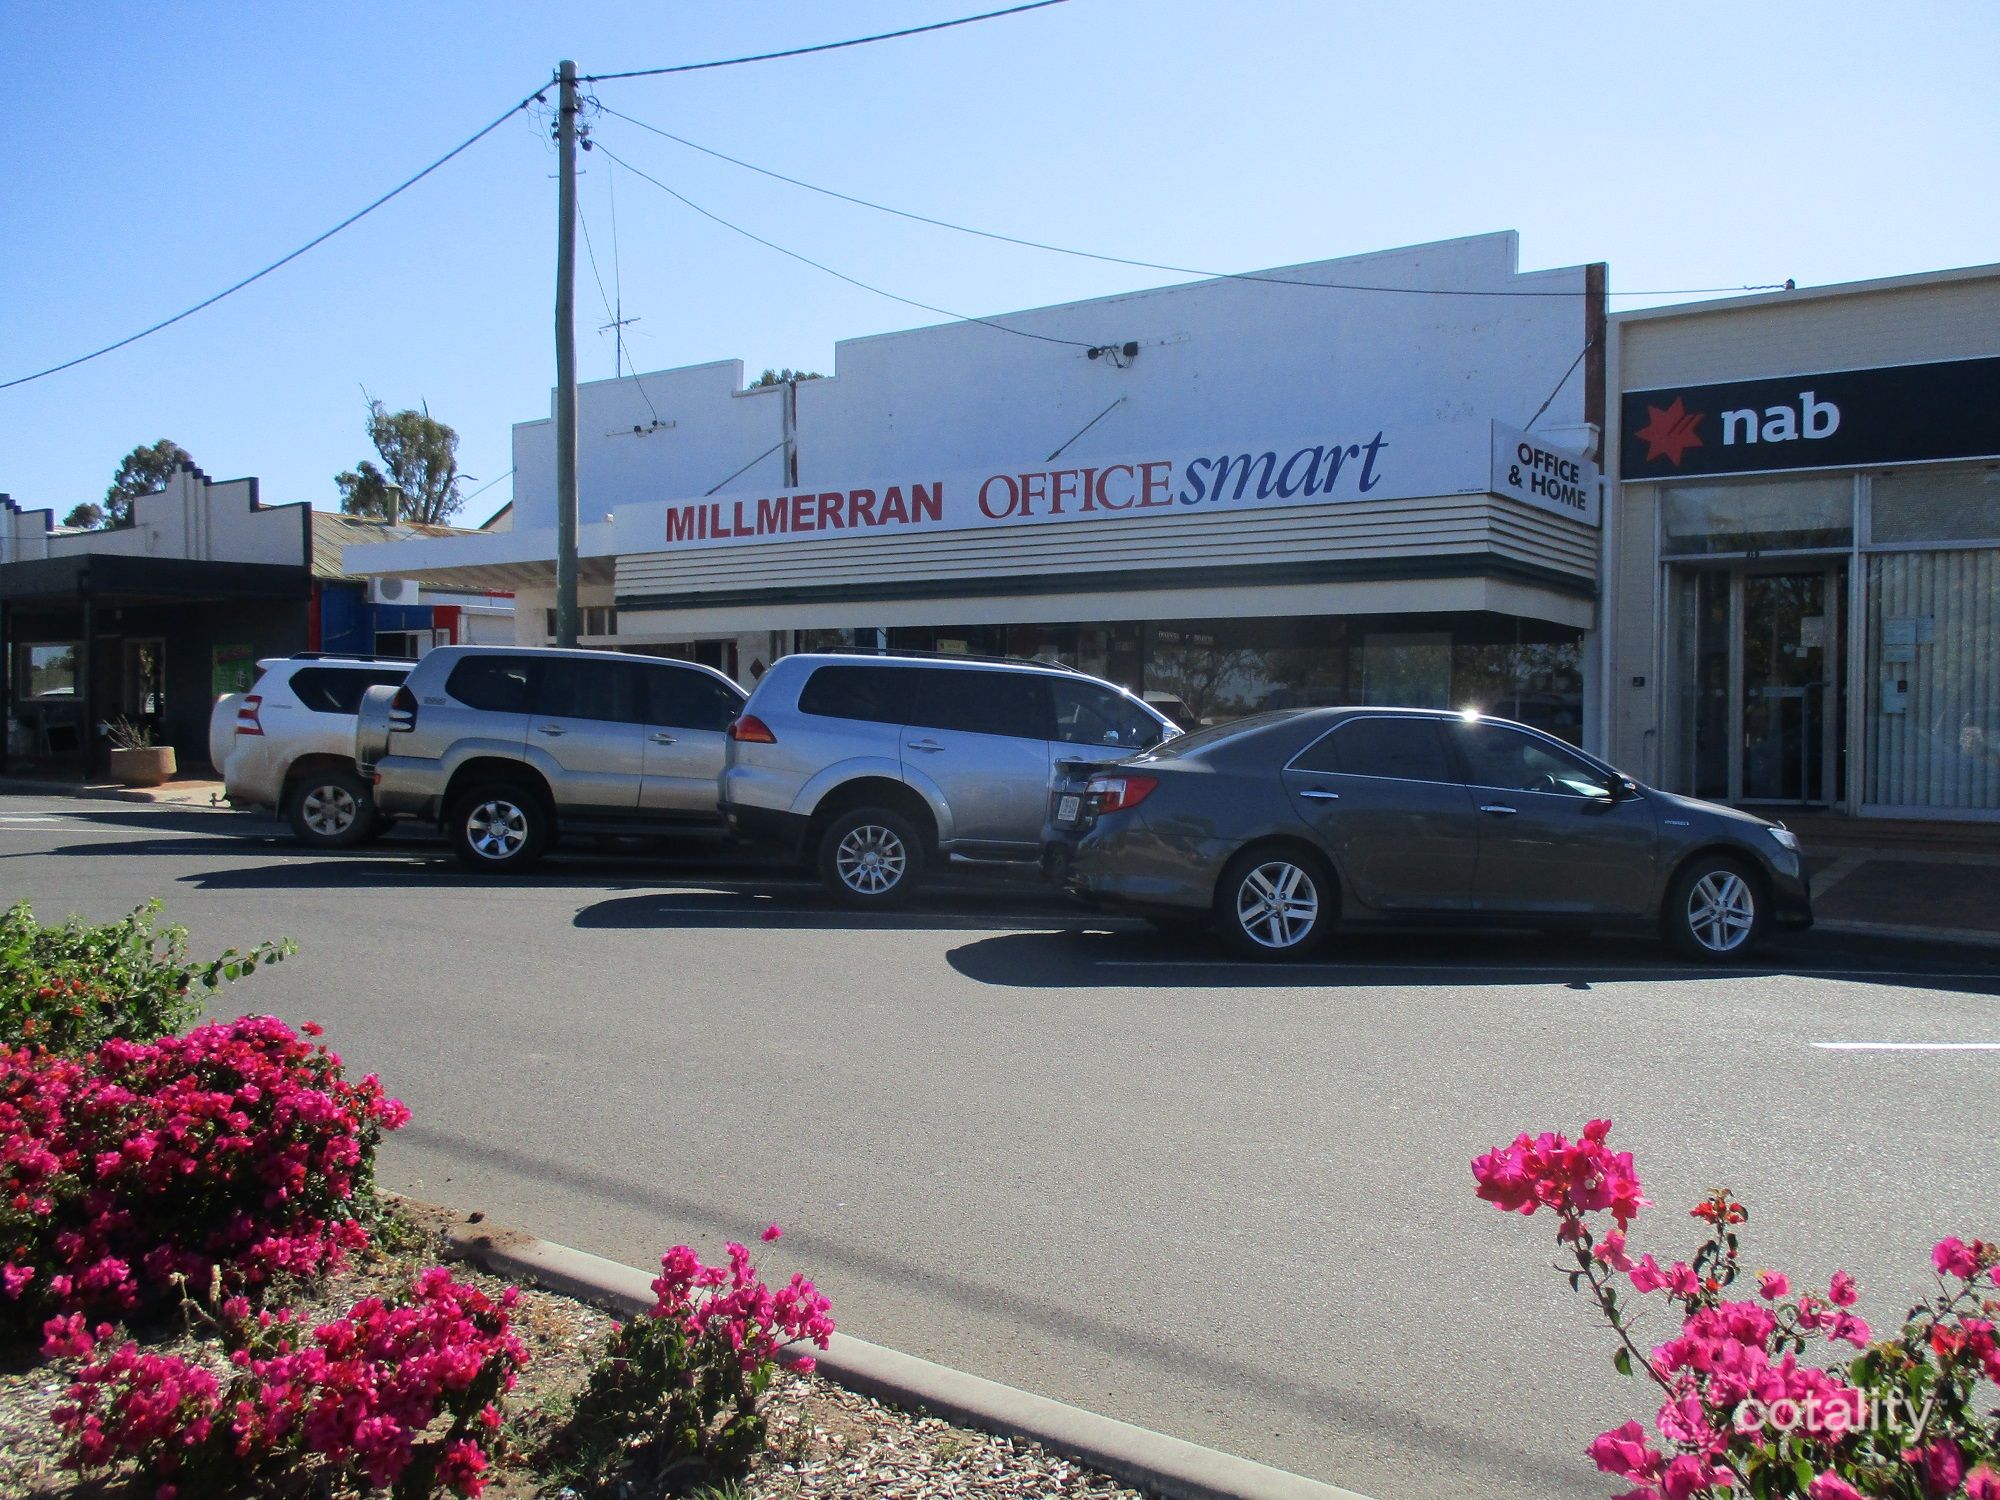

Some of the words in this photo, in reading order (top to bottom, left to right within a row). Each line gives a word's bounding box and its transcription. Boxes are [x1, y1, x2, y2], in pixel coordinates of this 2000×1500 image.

[1721, 391, 1841, 446] nab
[666, 482, 943, 542] MILLMERRAN
[978, 461, 1174, 519] OFFICE
[1179, 431, 1389, 505] smart
[1517, 443, 1580, 482] OFFICE
[1508, 465, 1523, 489] &
[1532, 474, 1587, 512] HOME
